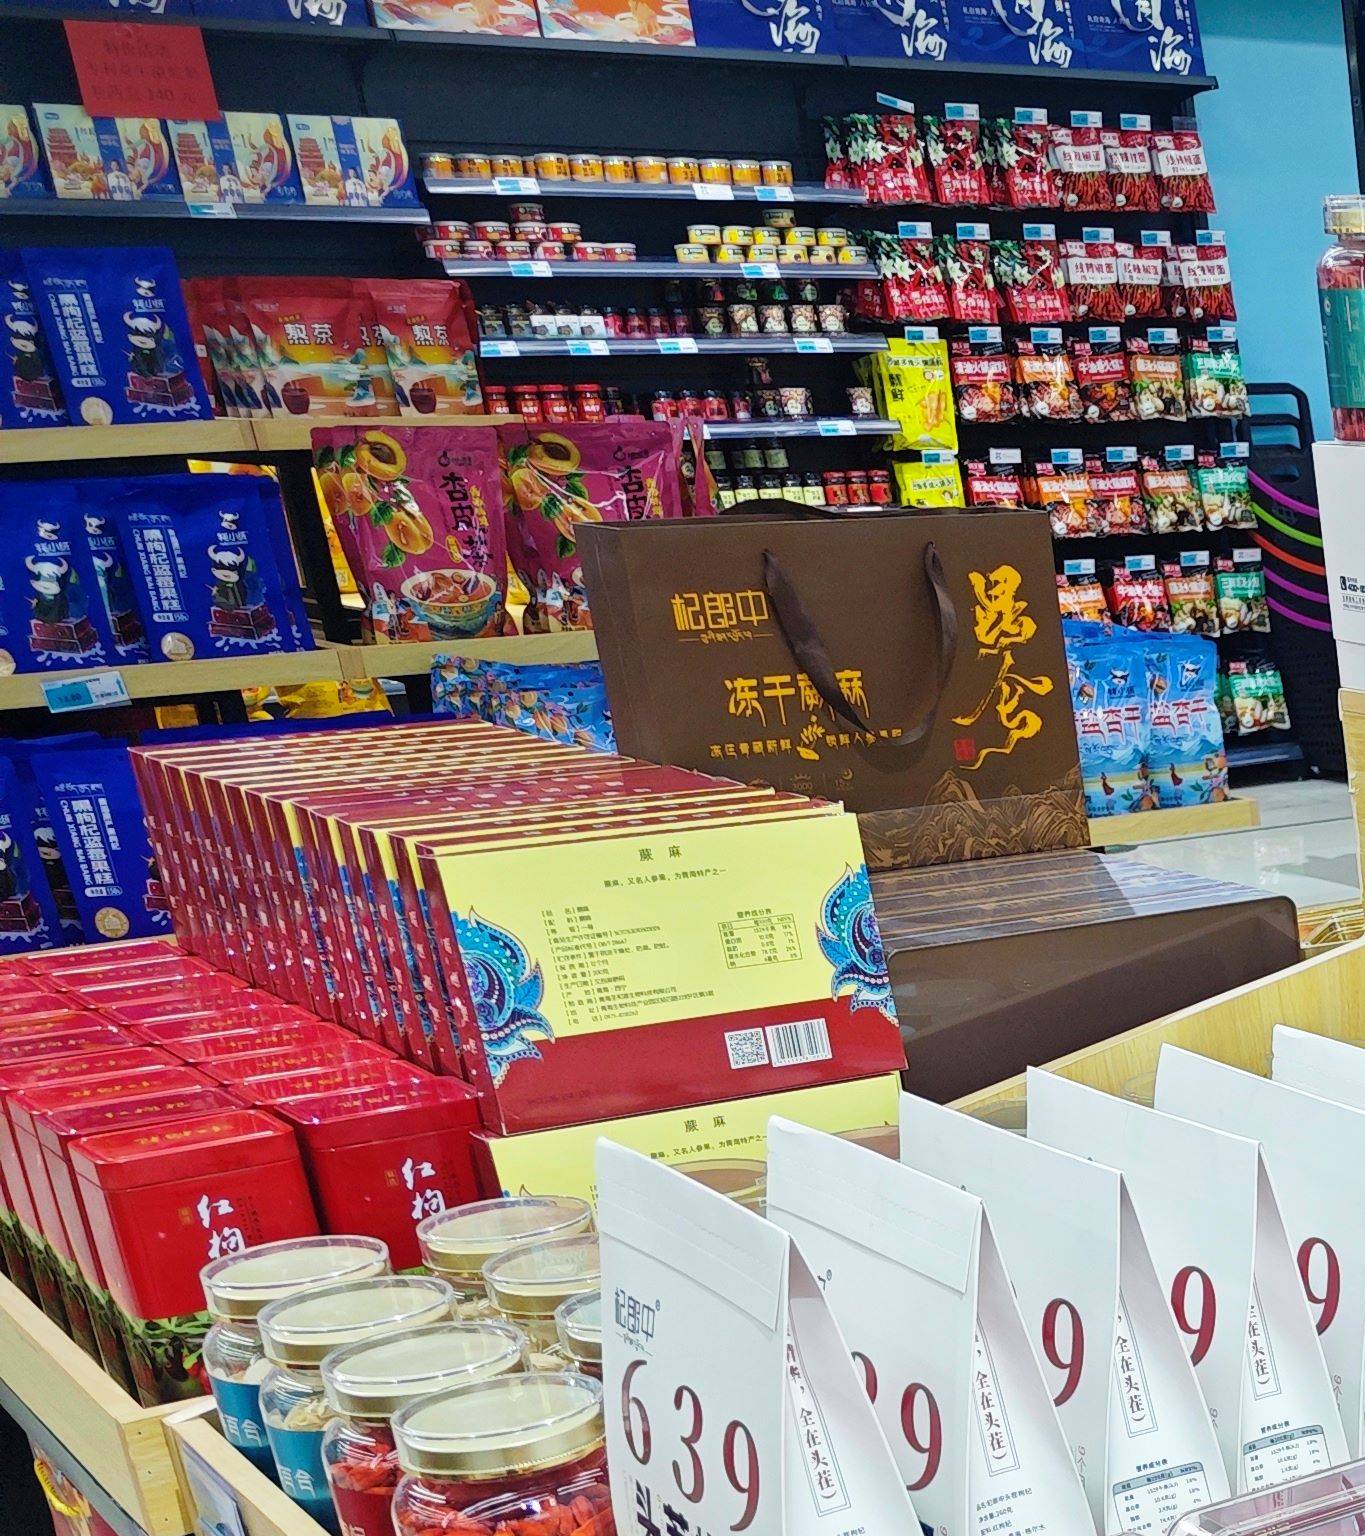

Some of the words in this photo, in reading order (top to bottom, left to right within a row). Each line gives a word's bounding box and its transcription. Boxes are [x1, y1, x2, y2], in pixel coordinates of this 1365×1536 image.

[284, 323, 333, 345] 熬茶
[672, 589, 769, 632] 杞郎中
[614, 1287, 656, 1340] 杞郎中
[1170, 1265, 1217, 1368] 9
[1296, 1236, 1341, 1337] 9
[1041, 1297, 1085, 1408] 9
